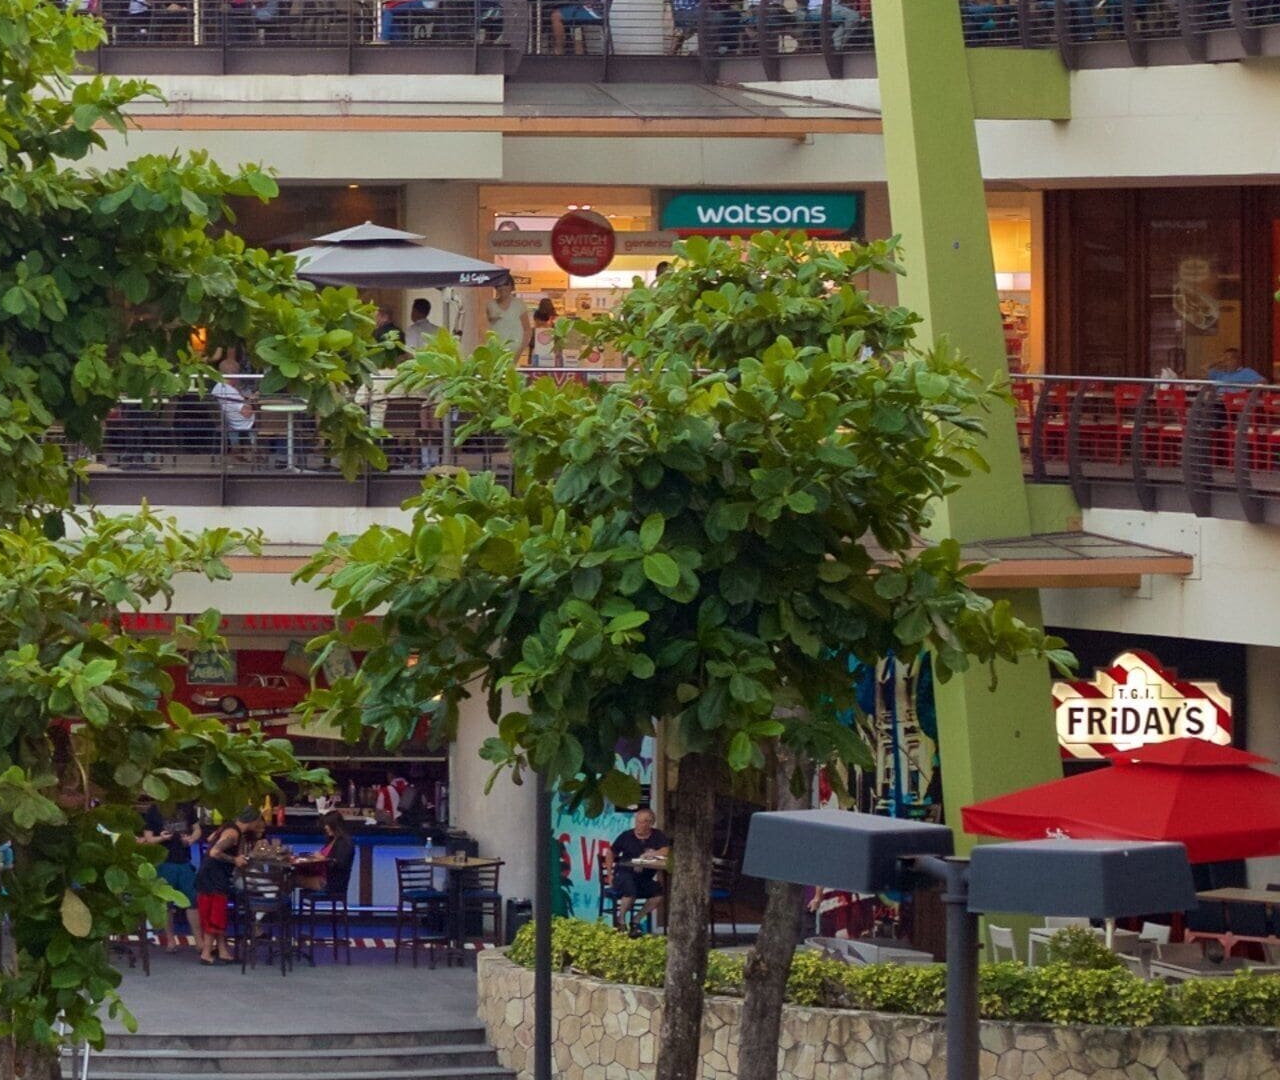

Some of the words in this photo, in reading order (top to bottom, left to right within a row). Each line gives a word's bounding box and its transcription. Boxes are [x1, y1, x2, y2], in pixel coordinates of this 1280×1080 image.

[697, 204, 826, 223] watsons
[492, 237, 543, 248] watsons
[558, 234, 608, 245] SWITCH
[1118, 688, 1154, 700] T.G.I.
